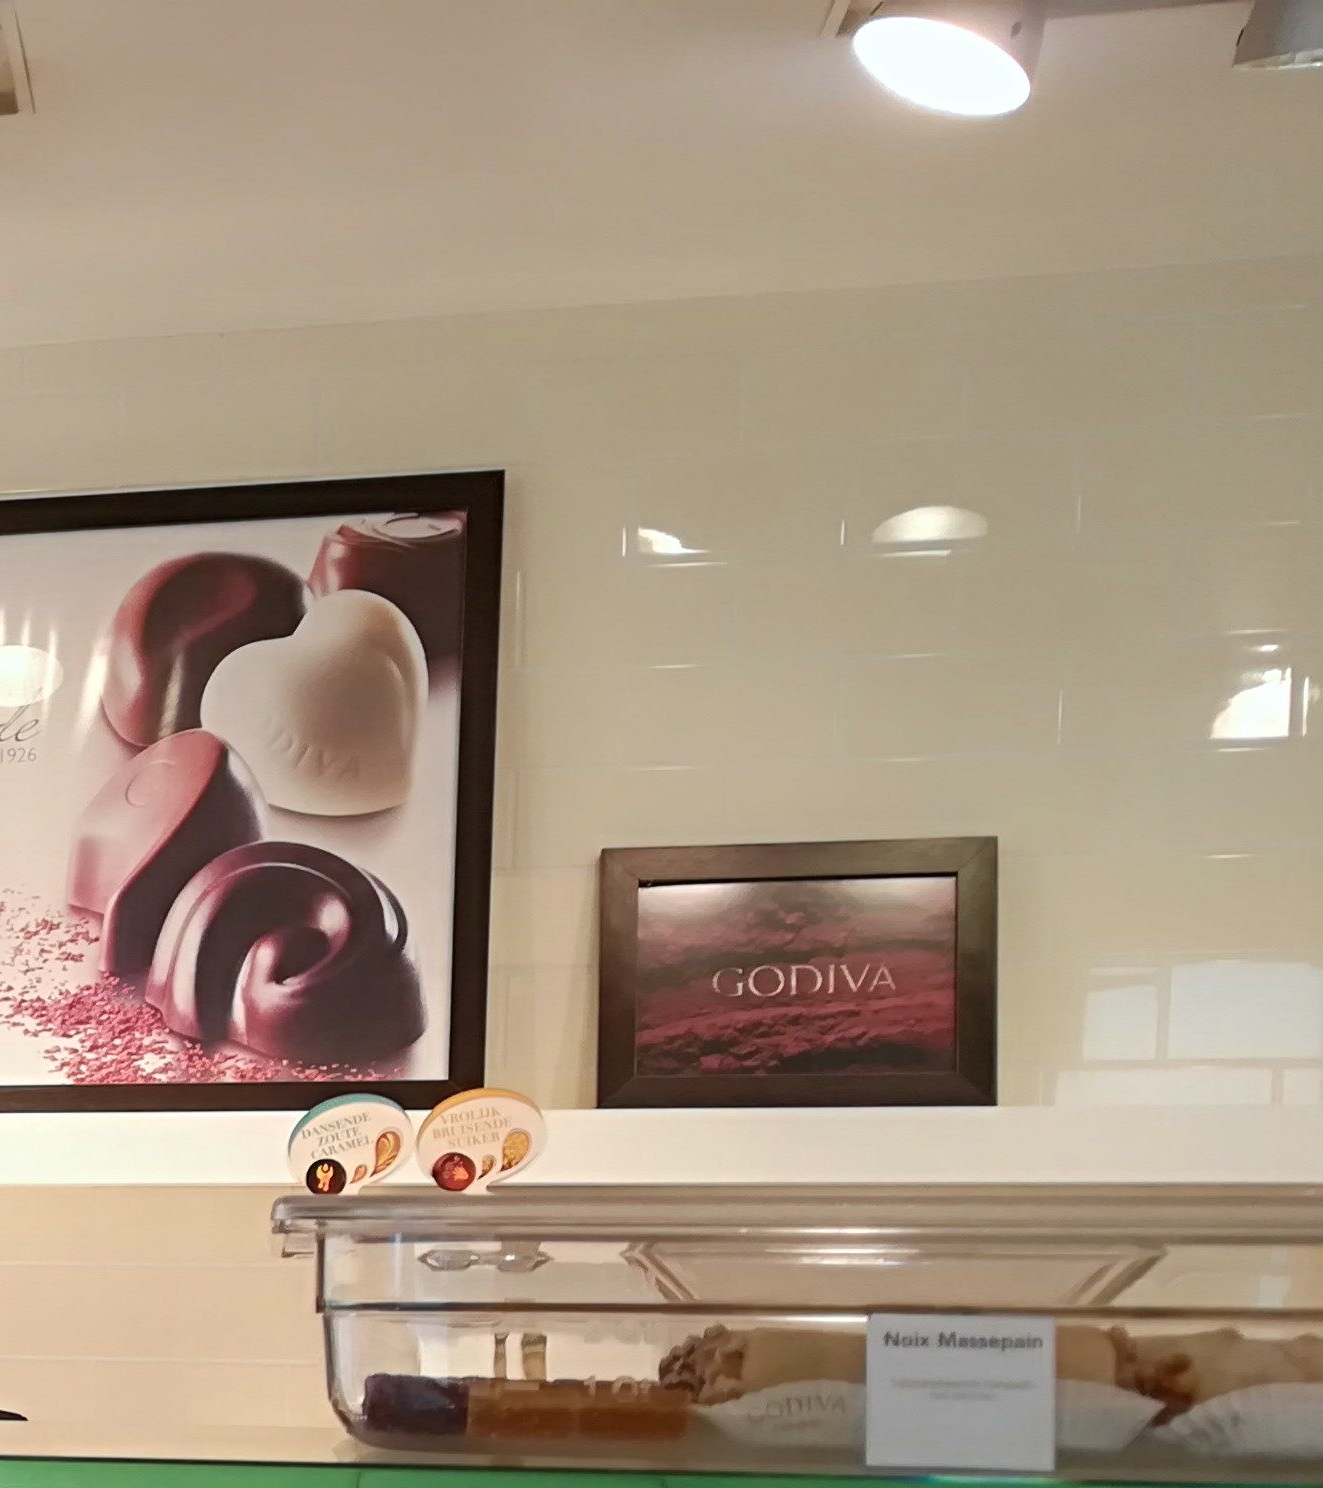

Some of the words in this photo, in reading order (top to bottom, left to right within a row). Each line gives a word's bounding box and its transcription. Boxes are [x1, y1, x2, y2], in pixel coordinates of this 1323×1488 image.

[0, 749, 37, 763] 1926
[712, 963, 896, 998] GODIVA
[301, 1111, 372, 1140] DANSENDE
[439, 1106, 502, 1125] VROLIJK
[317, 1127, 361, 1148] ZOUTE
[432, 1116, 513, 1140] BRUISENDE
[311, 1137, 375, 1160] CARAMEL
[883, 1331, 930, 1349] Noix
[938, 1331, 1044, 1353] Massepain
